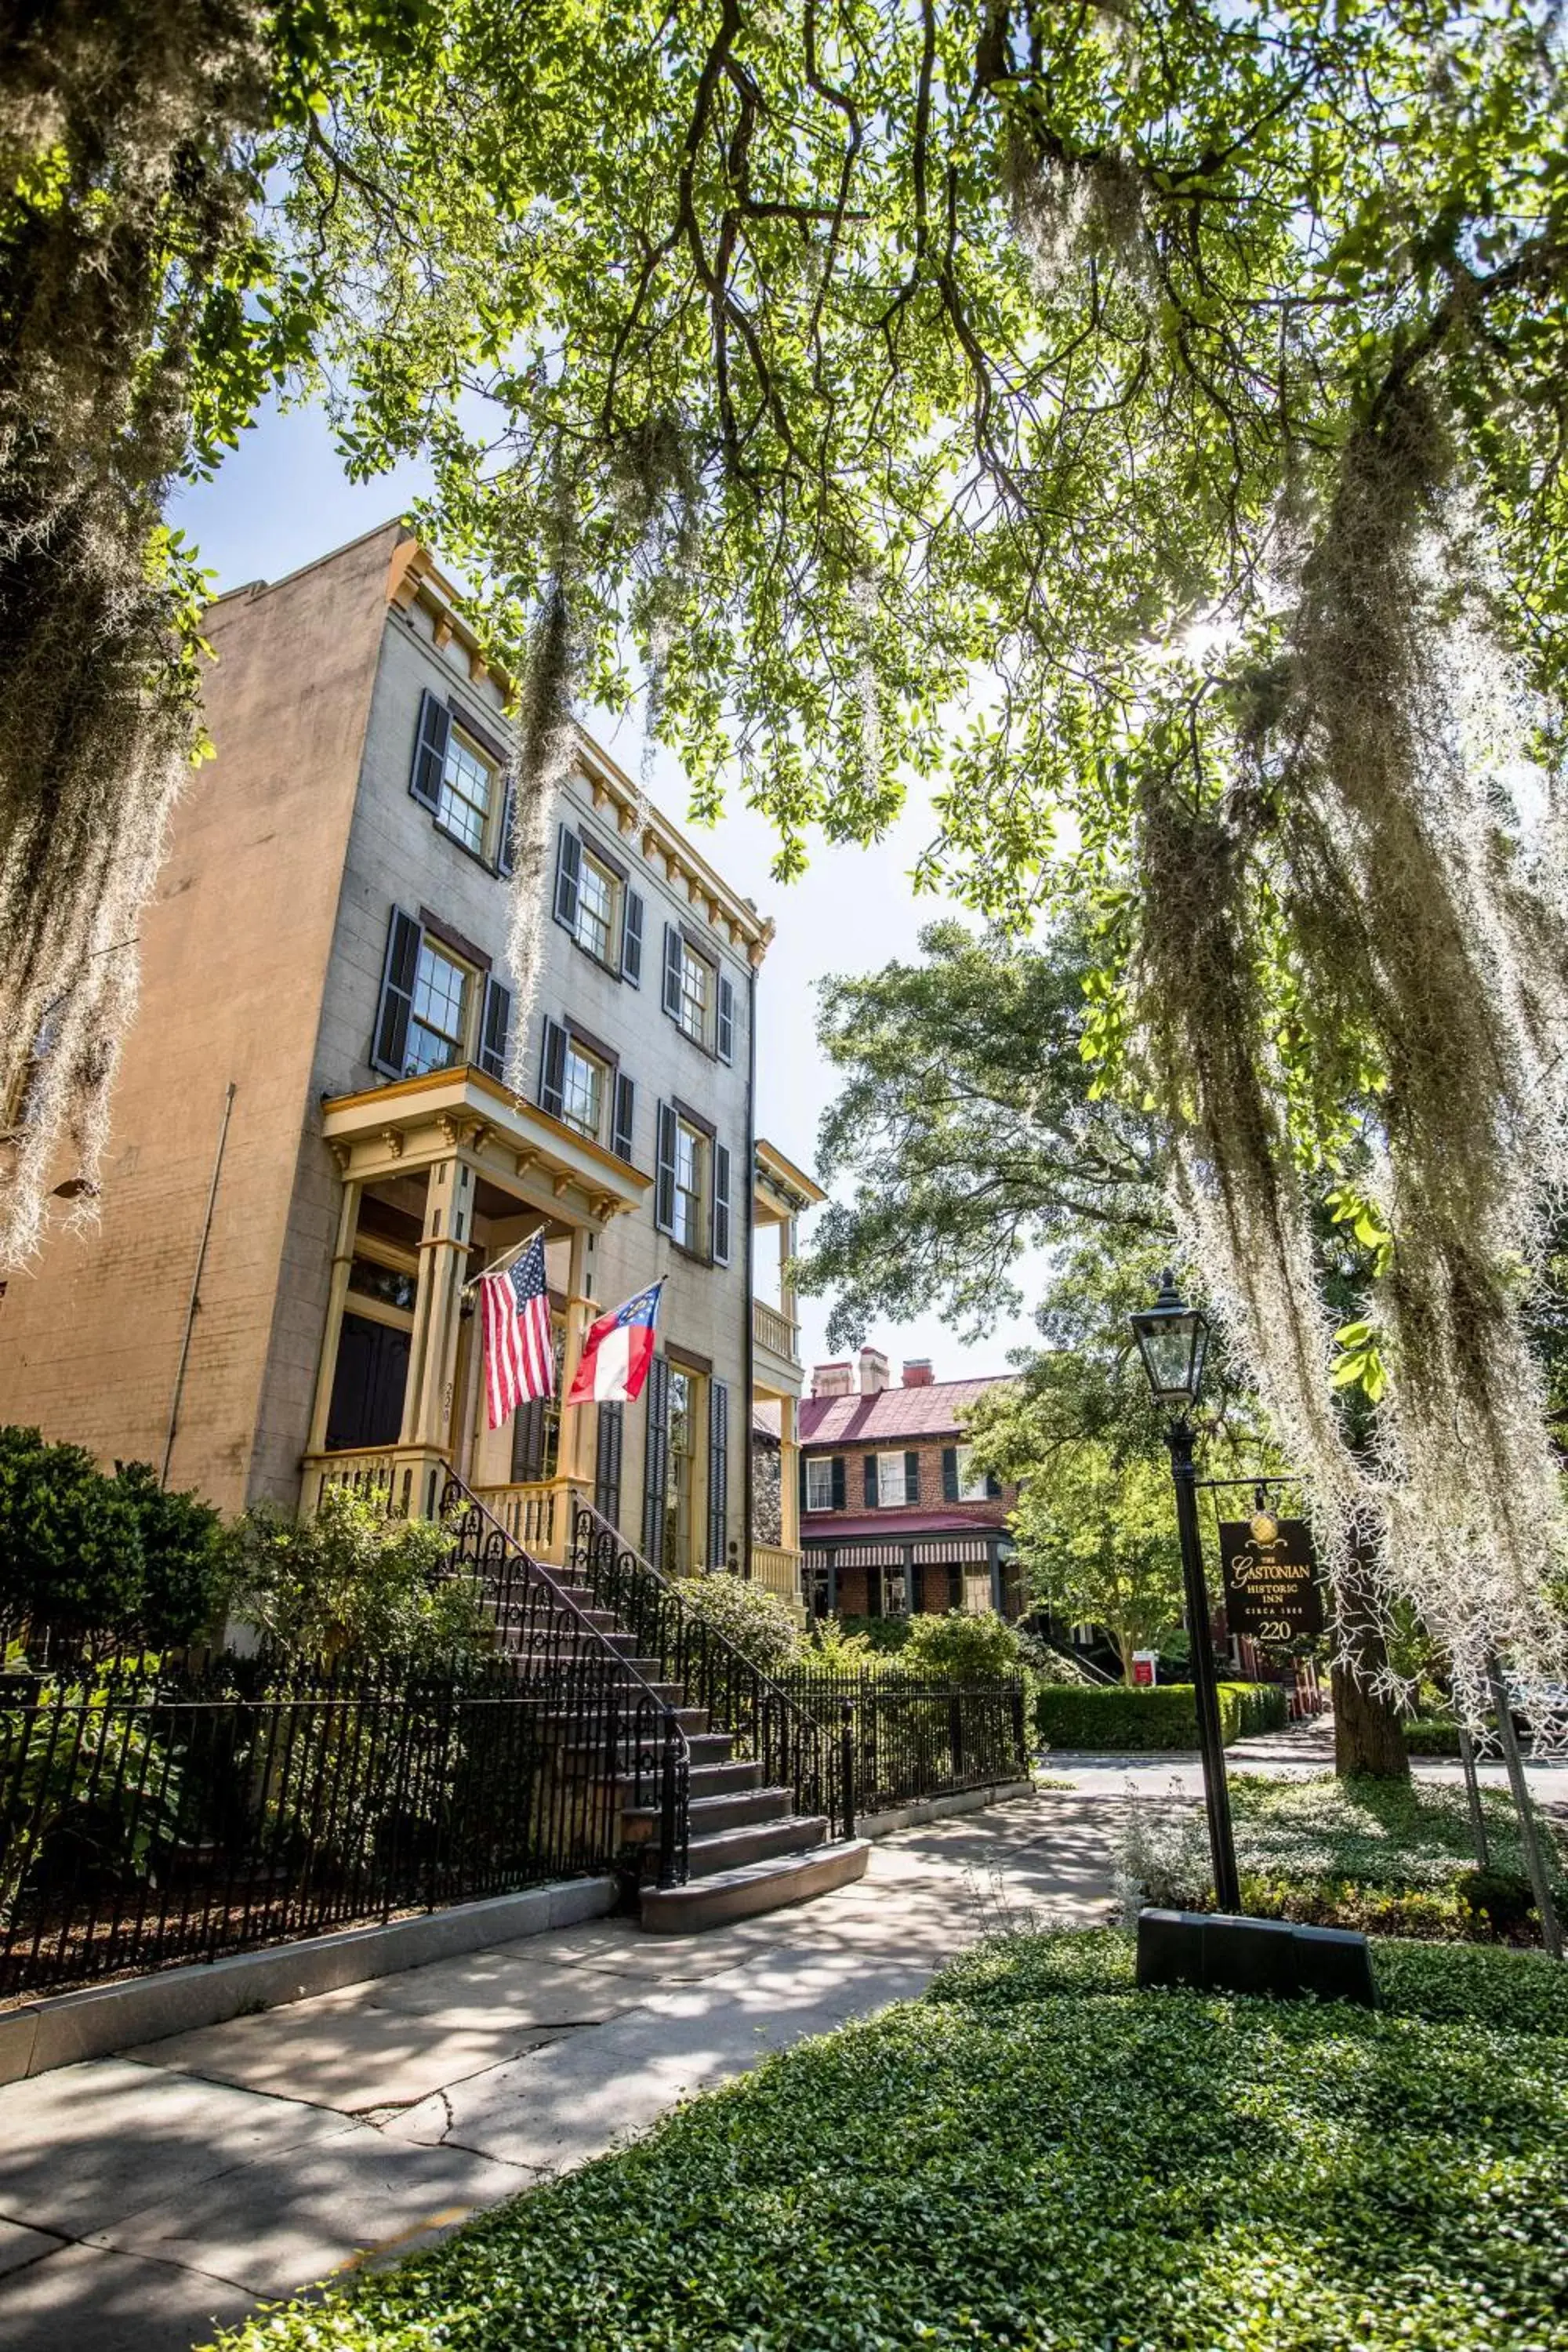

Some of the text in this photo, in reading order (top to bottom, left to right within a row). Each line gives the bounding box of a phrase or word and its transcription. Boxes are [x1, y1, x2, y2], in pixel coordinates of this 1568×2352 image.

[1230, 1555, 1310, 1588] GASTONIAN
[1247, 1584, 1298, 1593] HISTORIC
[1263, 1595, 1283, 1603] INN
[1258, 1621, 1291, 1640] 220
